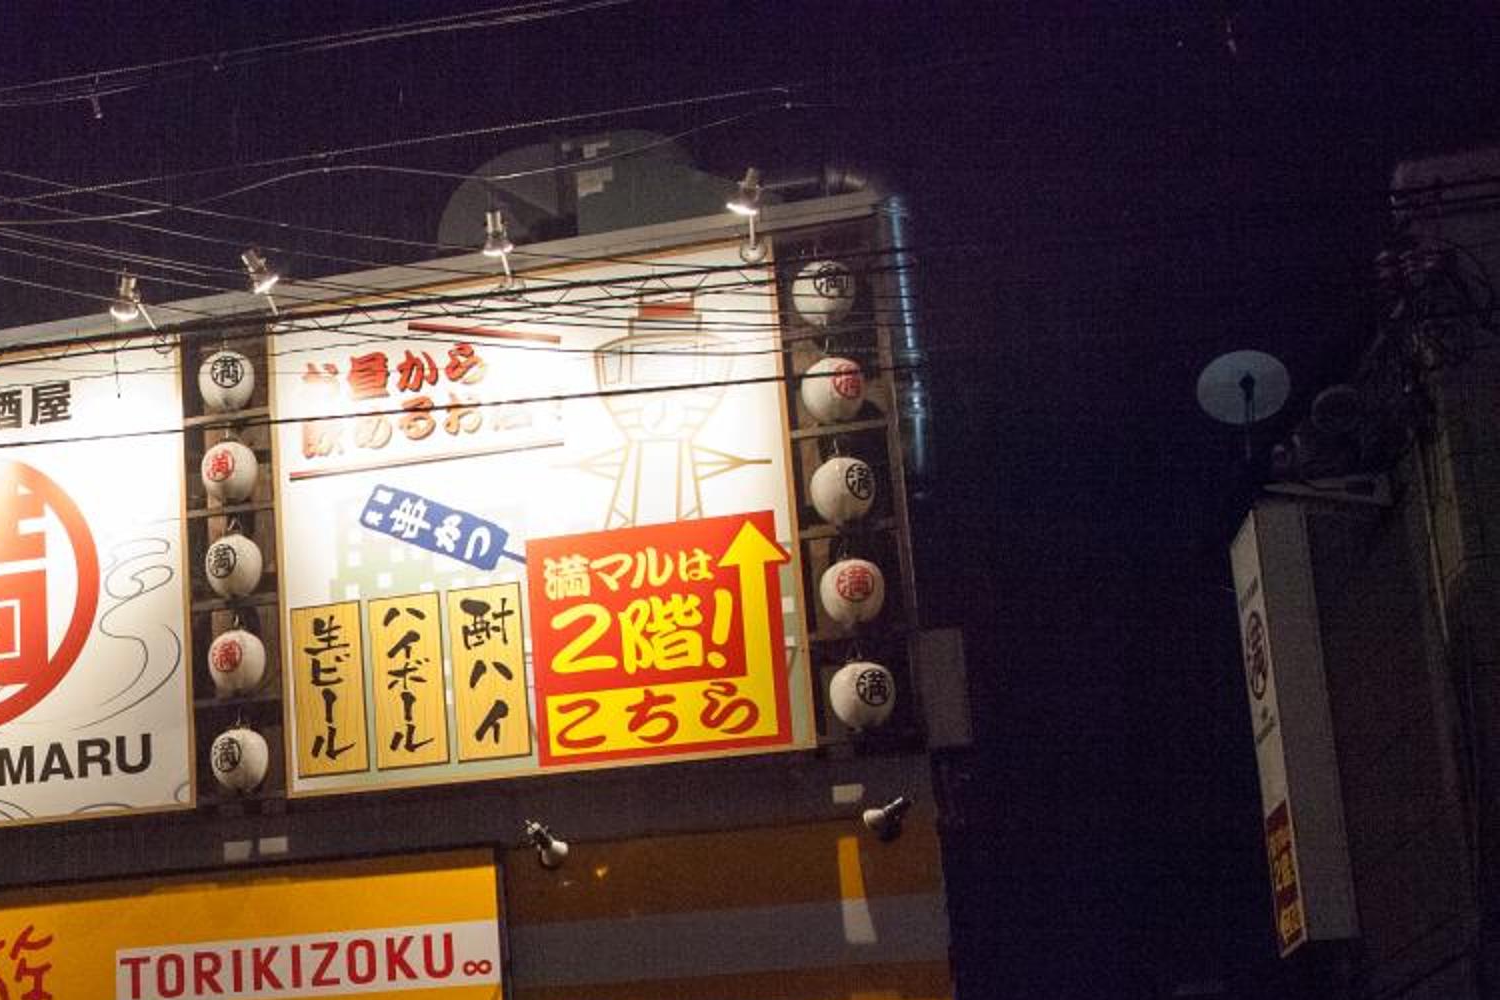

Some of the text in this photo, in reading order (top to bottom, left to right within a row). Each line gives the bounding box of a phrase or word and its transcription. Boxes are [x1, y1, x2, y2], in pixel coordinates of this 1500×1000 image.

[543, 547, 714, 600] 満マルは
[304, 615, 356, 760] 生ビール
[383, 607, 435, 752] ハイボール
[460, 598, 514, 745] 酎ハイ
[557, 681, 760, 749] こちら
